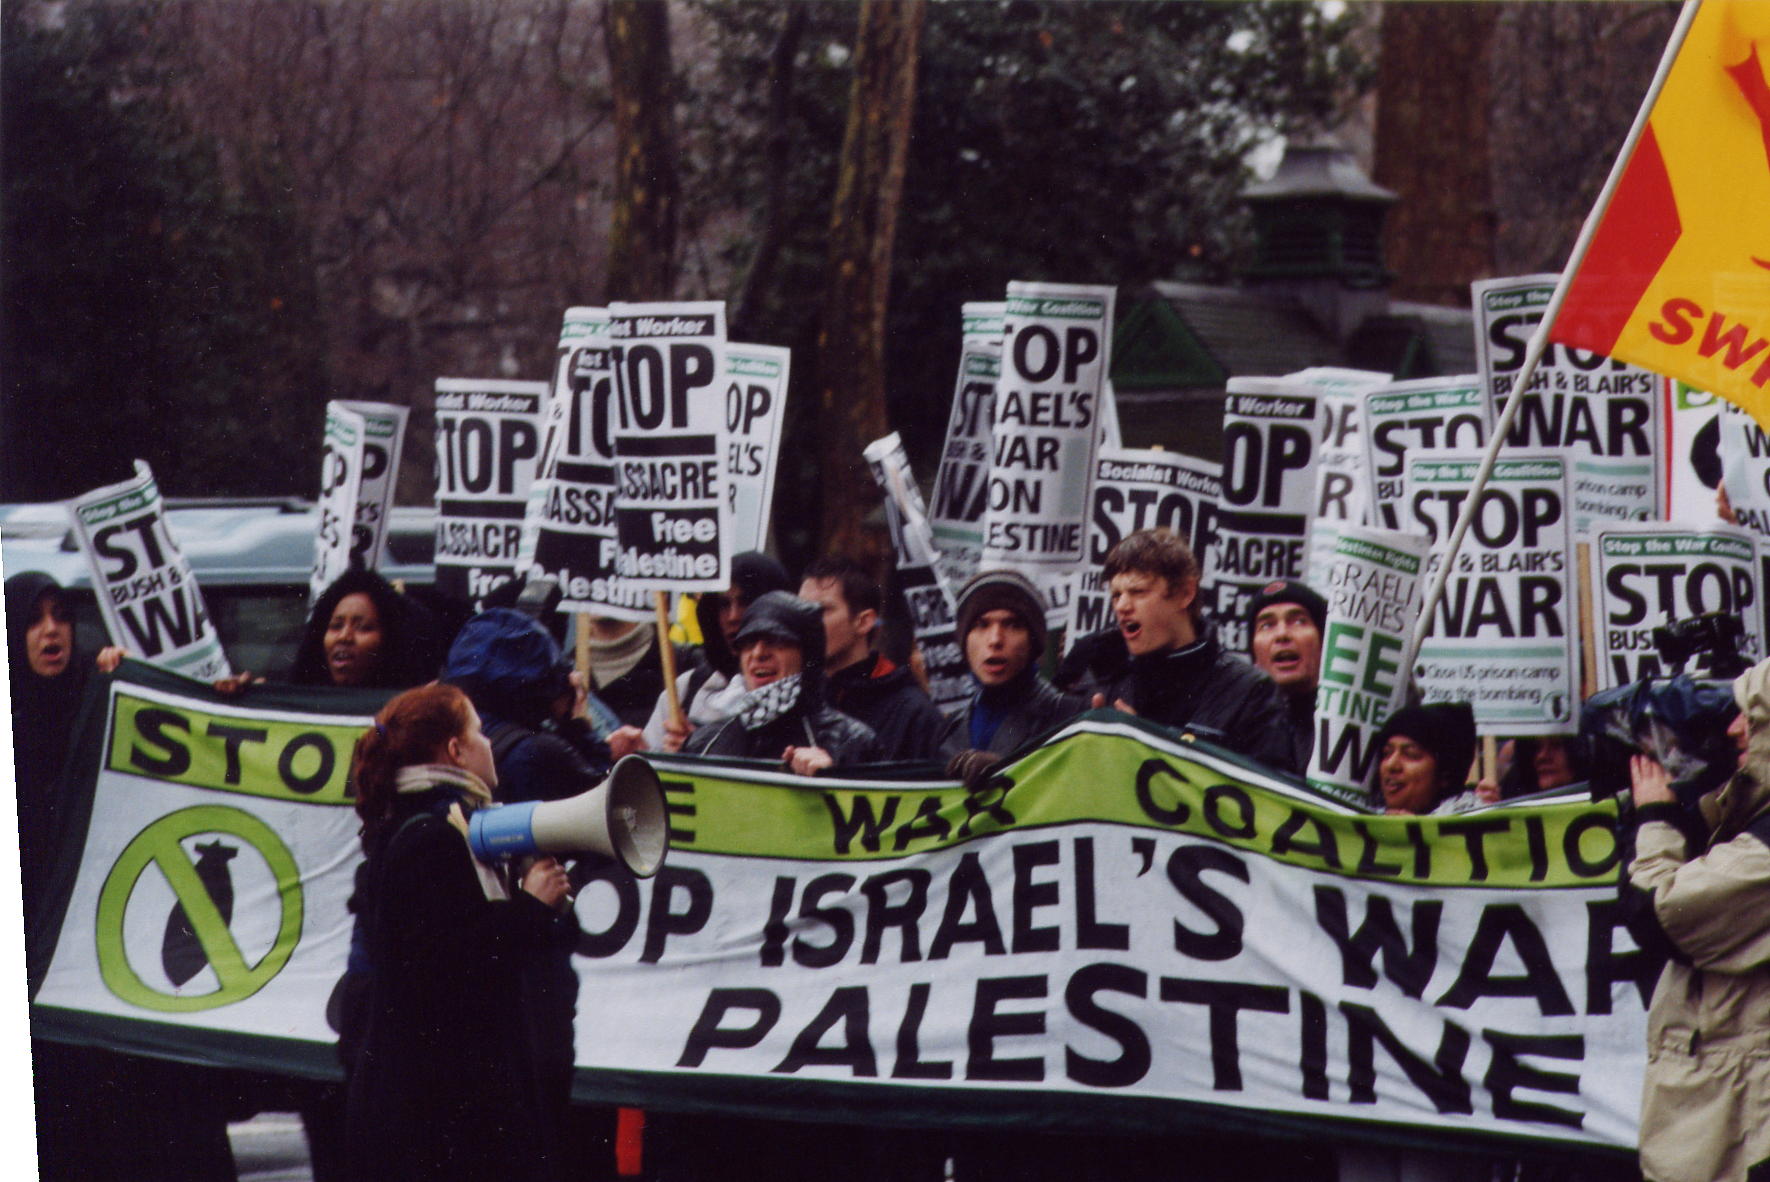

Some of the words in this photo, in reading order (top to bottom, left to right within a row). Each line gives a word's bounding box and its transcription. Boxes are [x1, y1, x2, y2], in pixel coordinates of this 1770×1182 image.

[635, 315, 707, 337] Worker
[1004, 324, 1100, 385] OP
[467, 392, 533, 412] Worker
[609, 343, 715, 431] TOP
[1000, 390, 1094, 429] AEL'S
[1237, 396, 1307, 416] Worker
[1574, 373, 1652, 396] BLAIR'S
[1373, 413, 1485, 477] STO
[1495, 393, 1652, 457] WAR
[434, 416, 539, 495] TOP
[1099, 461, 1172, 483] Socialist
[1222, 420, 1313, 507] OP
[989, 478, 1042, 515] ON
[1608, 483, 1648, 499] camp
[651, 510, 718, 544] Free
[985, 522, 1081, 553] ESTINE
[1413, 487, 1563, 549] STOP
[92, 511, 166, 583] ST
[1480, 551, 1564, 574] BLAIR'S
[1604, 539, 1642, 556] Stop
[1644, 537, 1671, 552] the
[1428, 575, 1566, 638] WAR
[1605, 561, 1754, 628] STOP
[1321, 621, 1404, 698] EE
[1608, 630, 1652, 650] BUS
[1521, 666, 1560, 682] camp
[1315, 684, 1390, 727] TINE
[129, 706, 354, 799] STO
[823, 773, 1017, 855] WAR
[759, 836, 1251, 968] ISRAEL'S
[675, 962, 1585, 1131] PALESTINE
